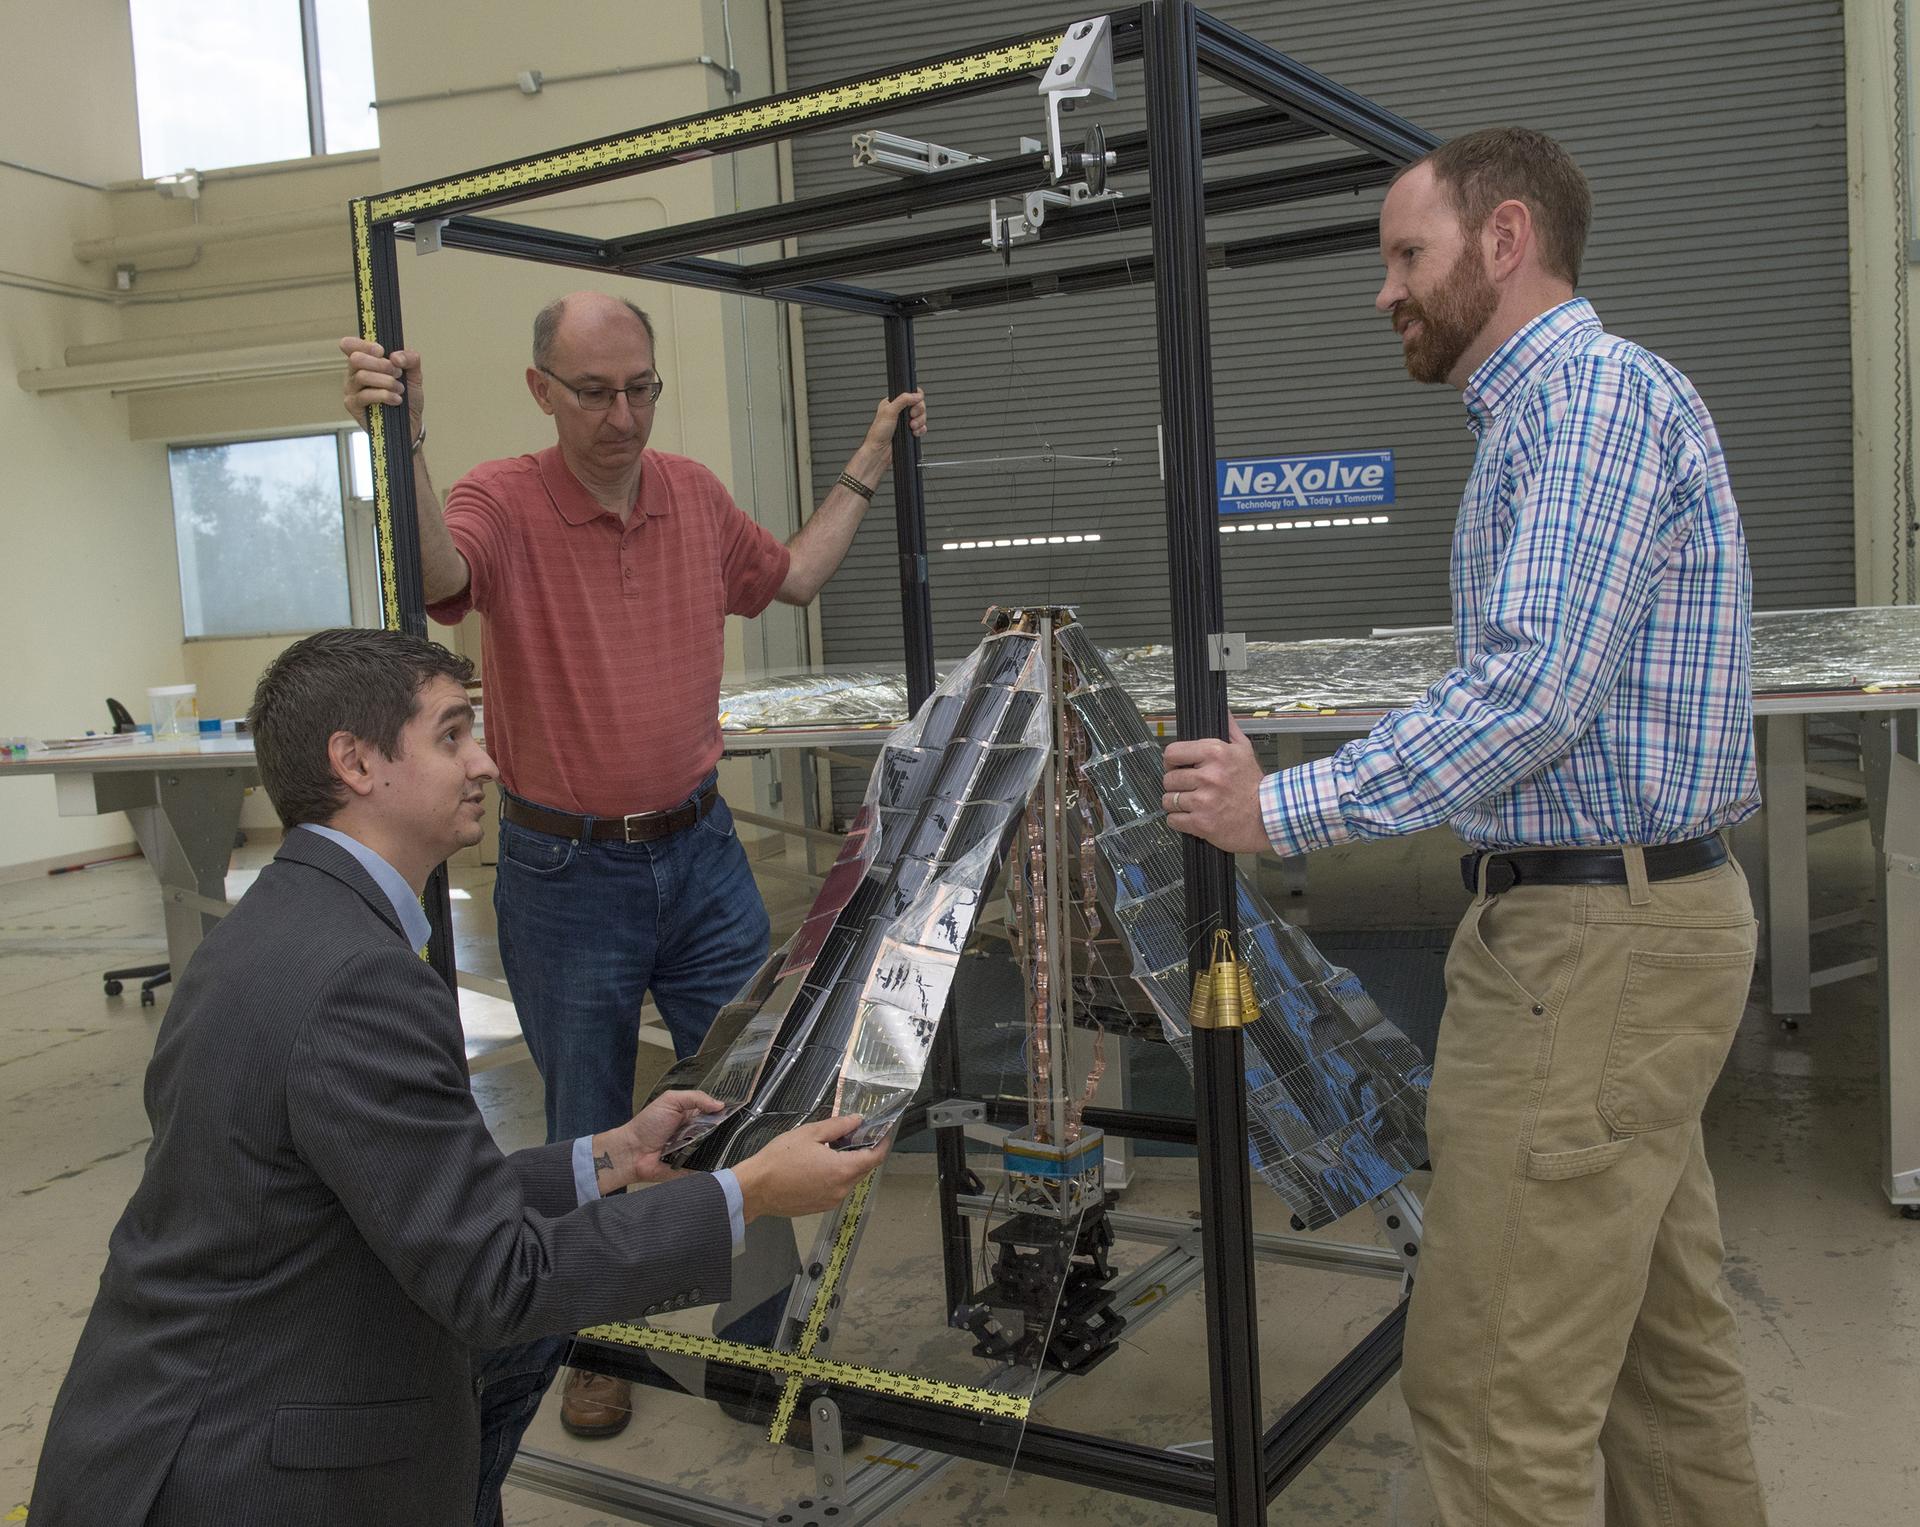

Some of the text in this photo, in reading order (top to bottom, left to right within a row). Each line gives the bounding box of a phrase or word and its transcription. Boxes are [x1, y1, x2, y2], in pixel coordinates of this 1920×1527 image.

[1224, 460, 1384, 506] NeXolve
[1236, 494, 1384, 510] Technology for Today & Tomorrow
